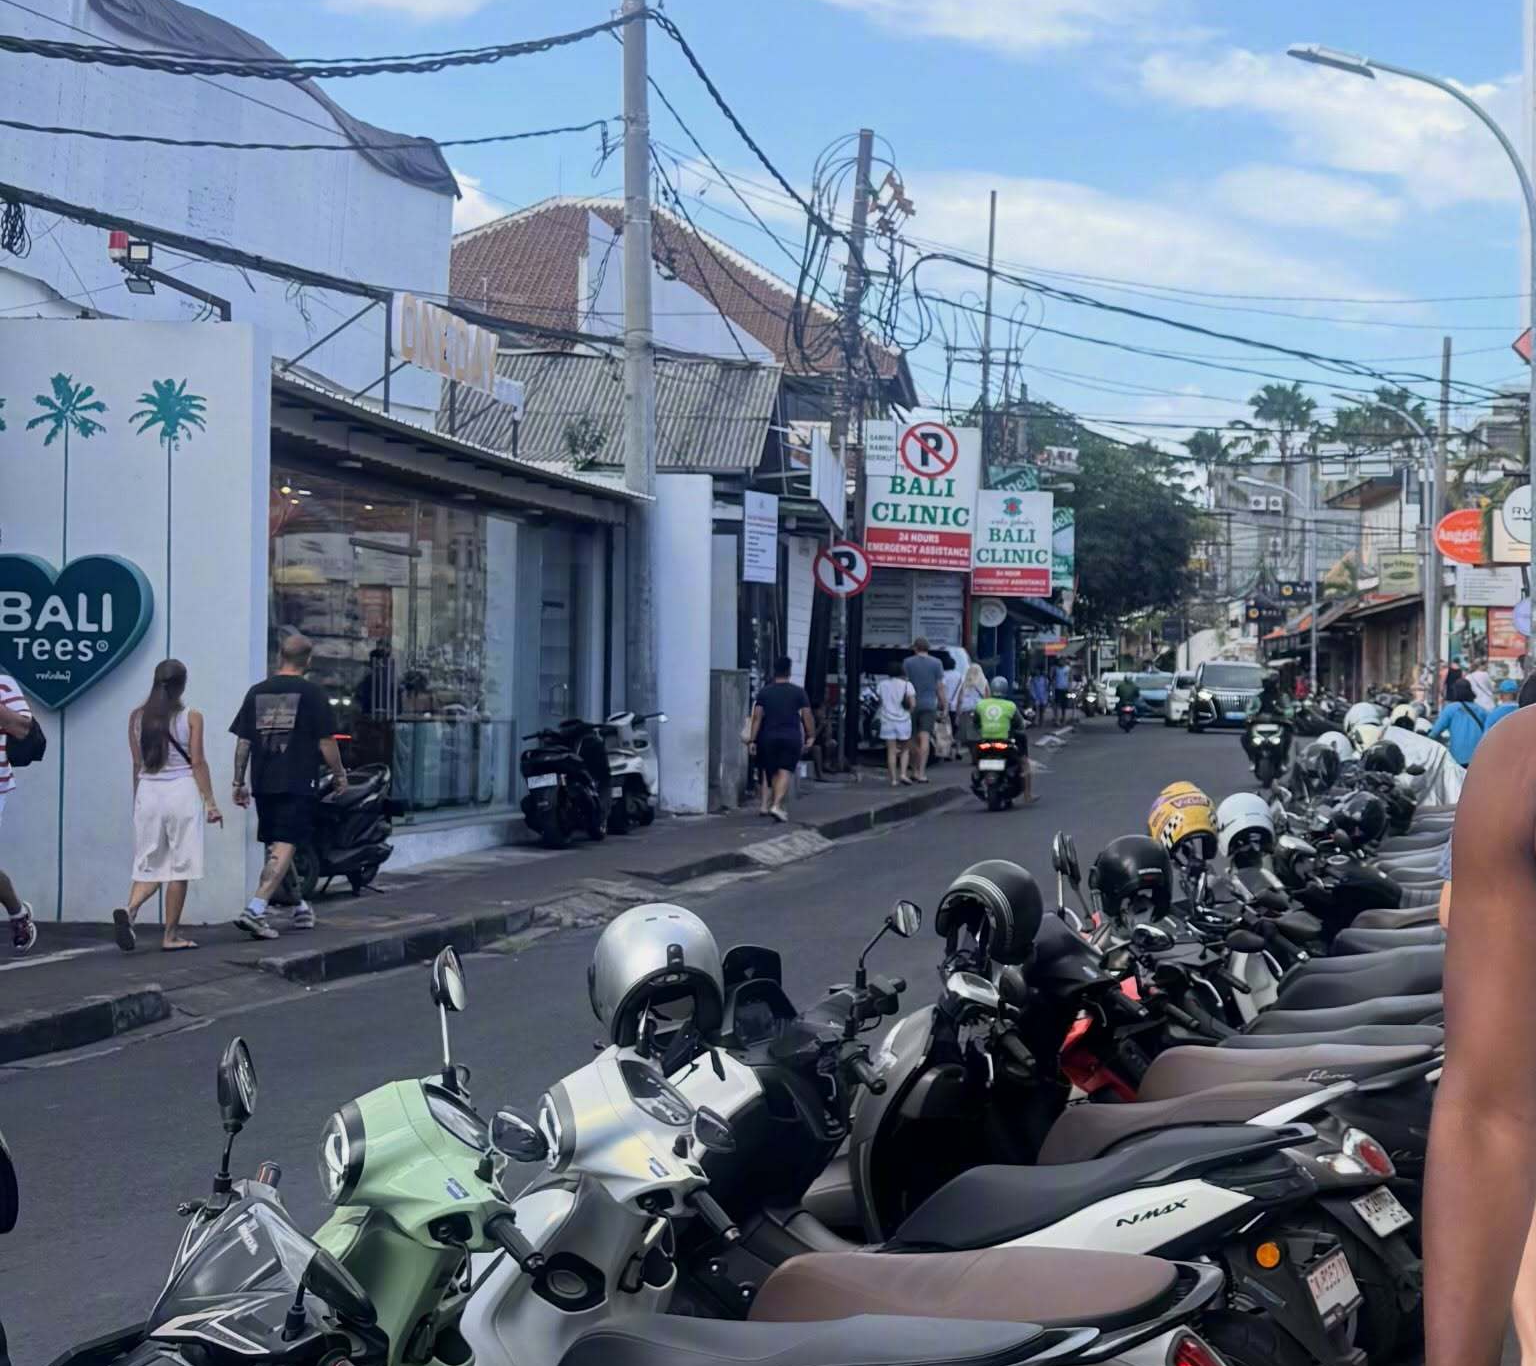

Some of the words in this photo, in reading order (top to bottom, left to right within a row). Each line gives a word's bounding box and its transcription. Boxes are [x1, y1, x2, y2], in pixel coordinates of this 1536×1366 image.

[888, 475, 956, 498] BALI
[871, 502, 970, 527] CLINIC
[988, 527, 1036, 544] BALI
[867, 541, 918, 554] EMERGENCY
[918, 545, 969, 557] ASSISTANCE
[975, 547, 1049, 564] CLINIC
[0, 590, 113, 633] BALI
